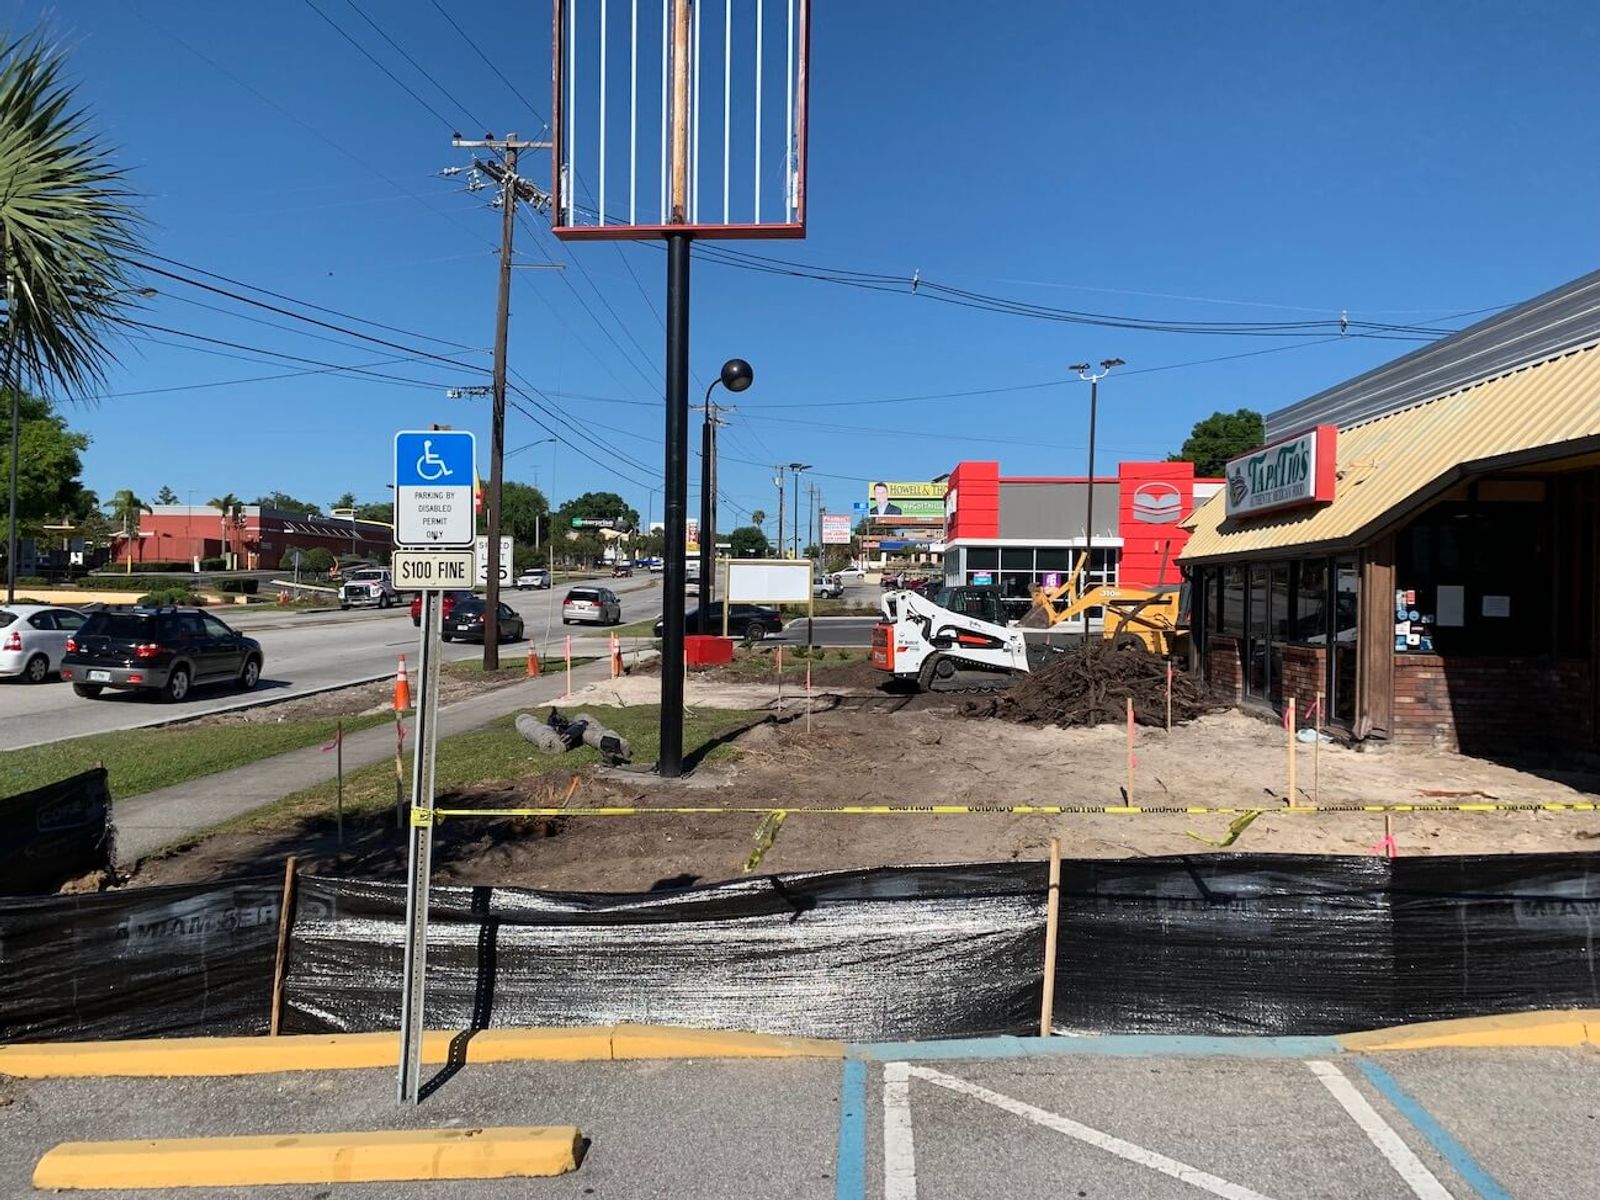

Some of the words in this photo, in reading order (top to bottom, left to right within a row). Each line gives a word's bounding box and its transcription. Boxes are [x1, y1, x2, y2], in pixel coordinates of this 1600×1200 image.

[414, 491, 444, 499] PARKING
[446, 491, 455, 499] BY
[418, 504, 452, 512] DISABLED
[422, 517, 448, 525] PERMIT
[426, 530, 443, 538] ONLY
[402, 560, 431, 579] $100
[438, 561, 465, 579] FINE
